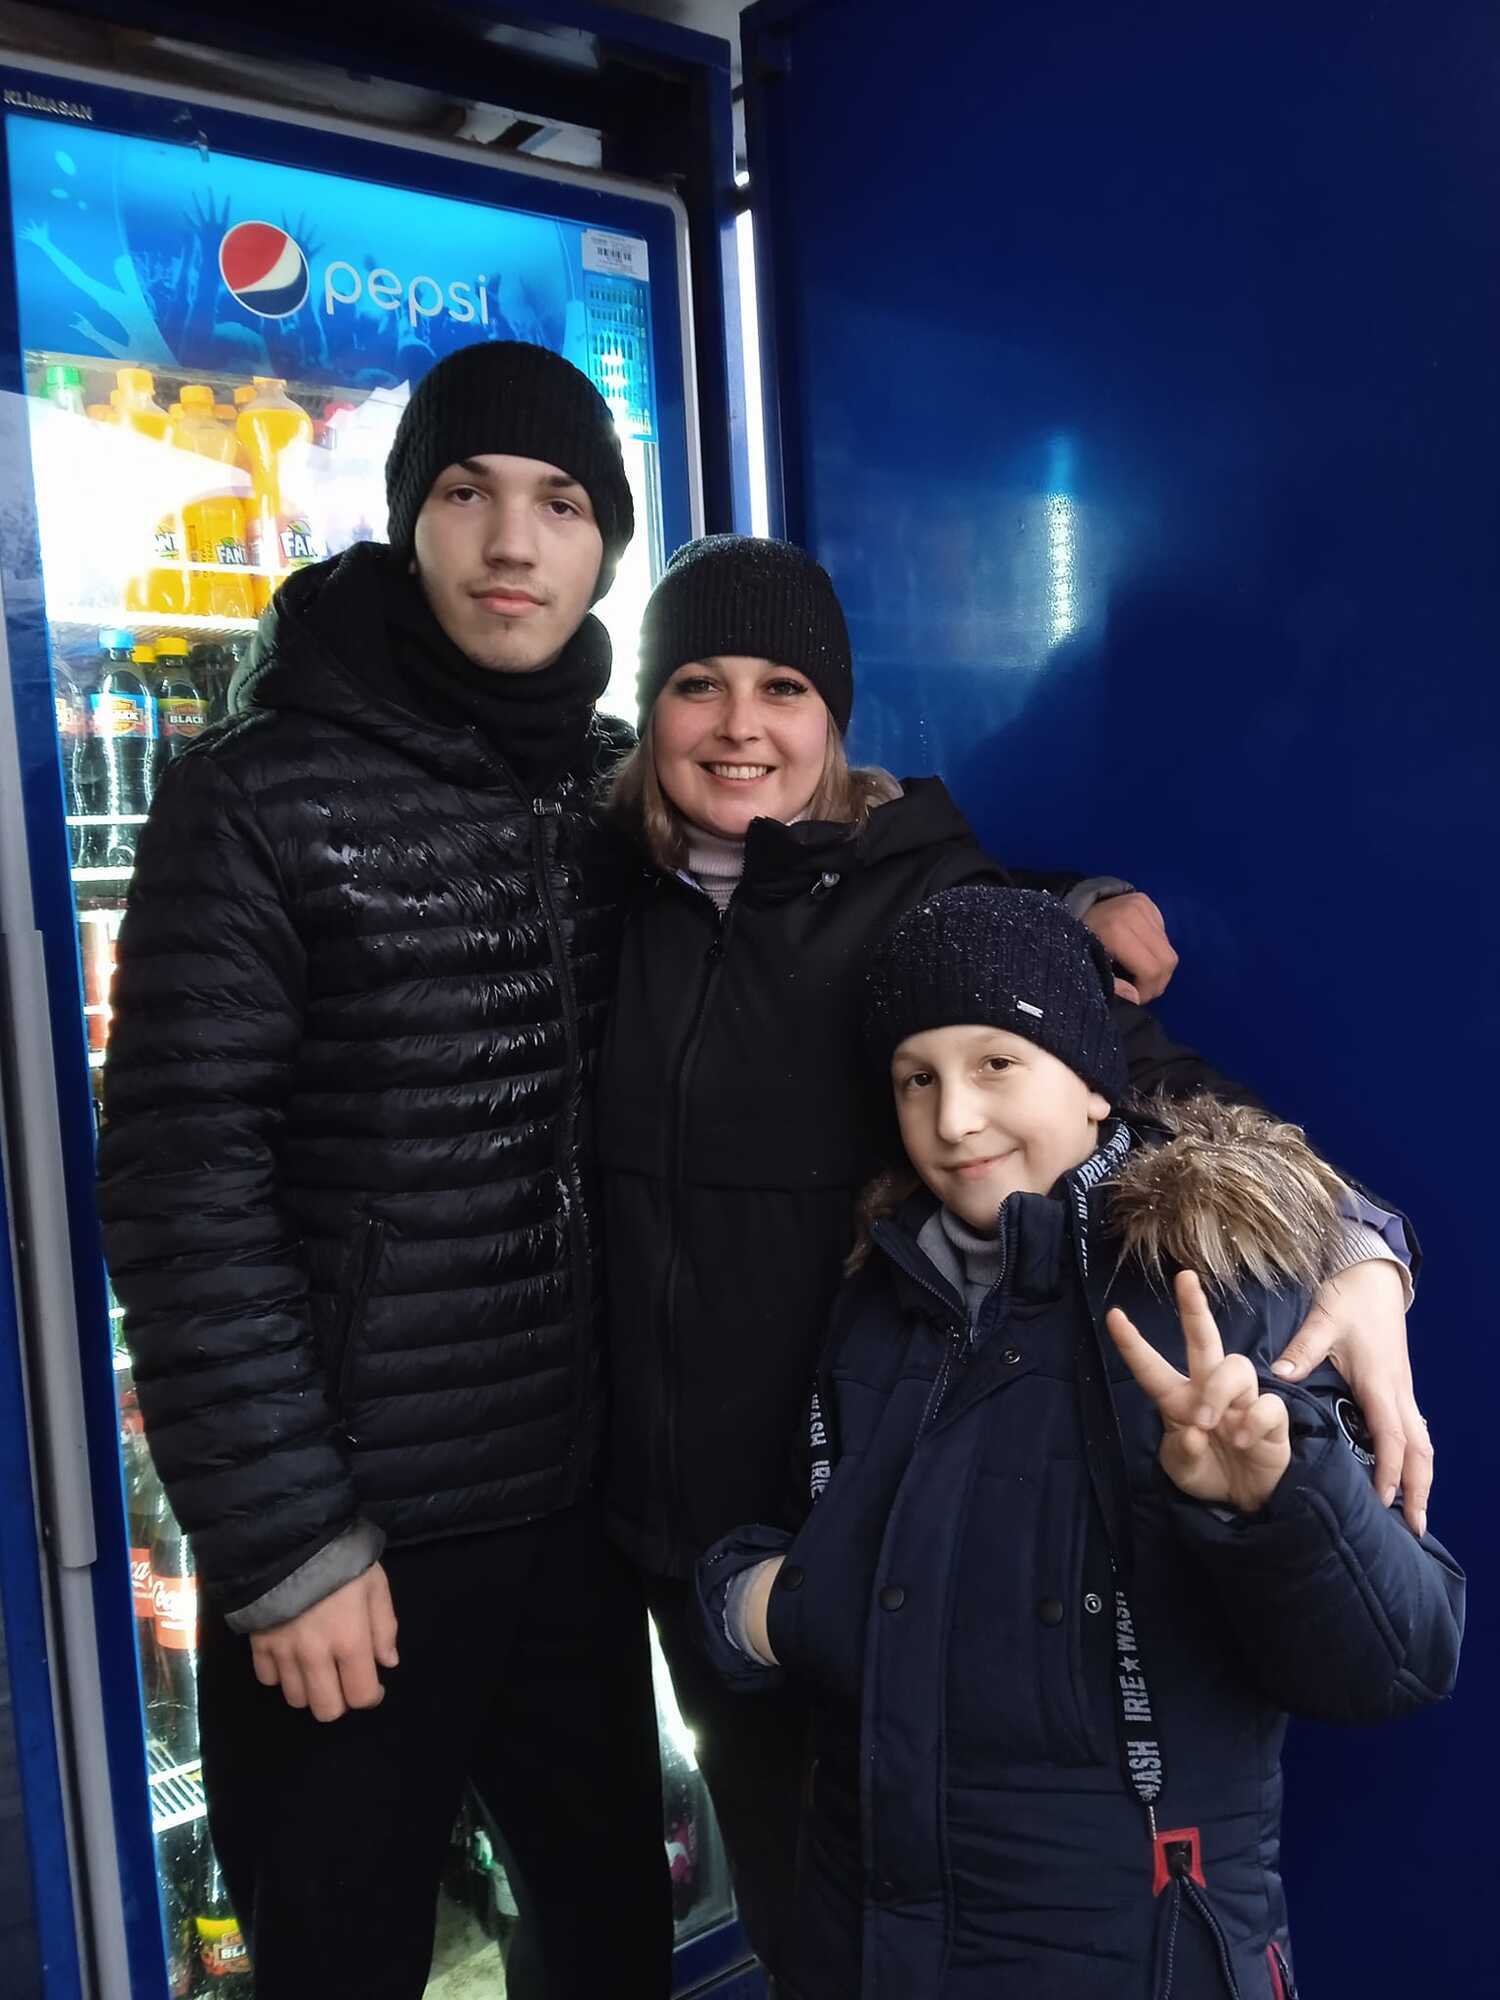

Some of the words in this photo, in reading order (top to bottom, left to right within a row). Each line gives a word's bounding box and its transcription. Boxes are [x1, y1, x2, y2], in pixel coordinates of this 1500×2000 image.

[325, 260, 489, 328] pepsi
[170, 714, 204, 724] BLACK
[1077, 1154, 1111, 1192] IRIE
[1119, 1675, 1152, 1722] IRIE
